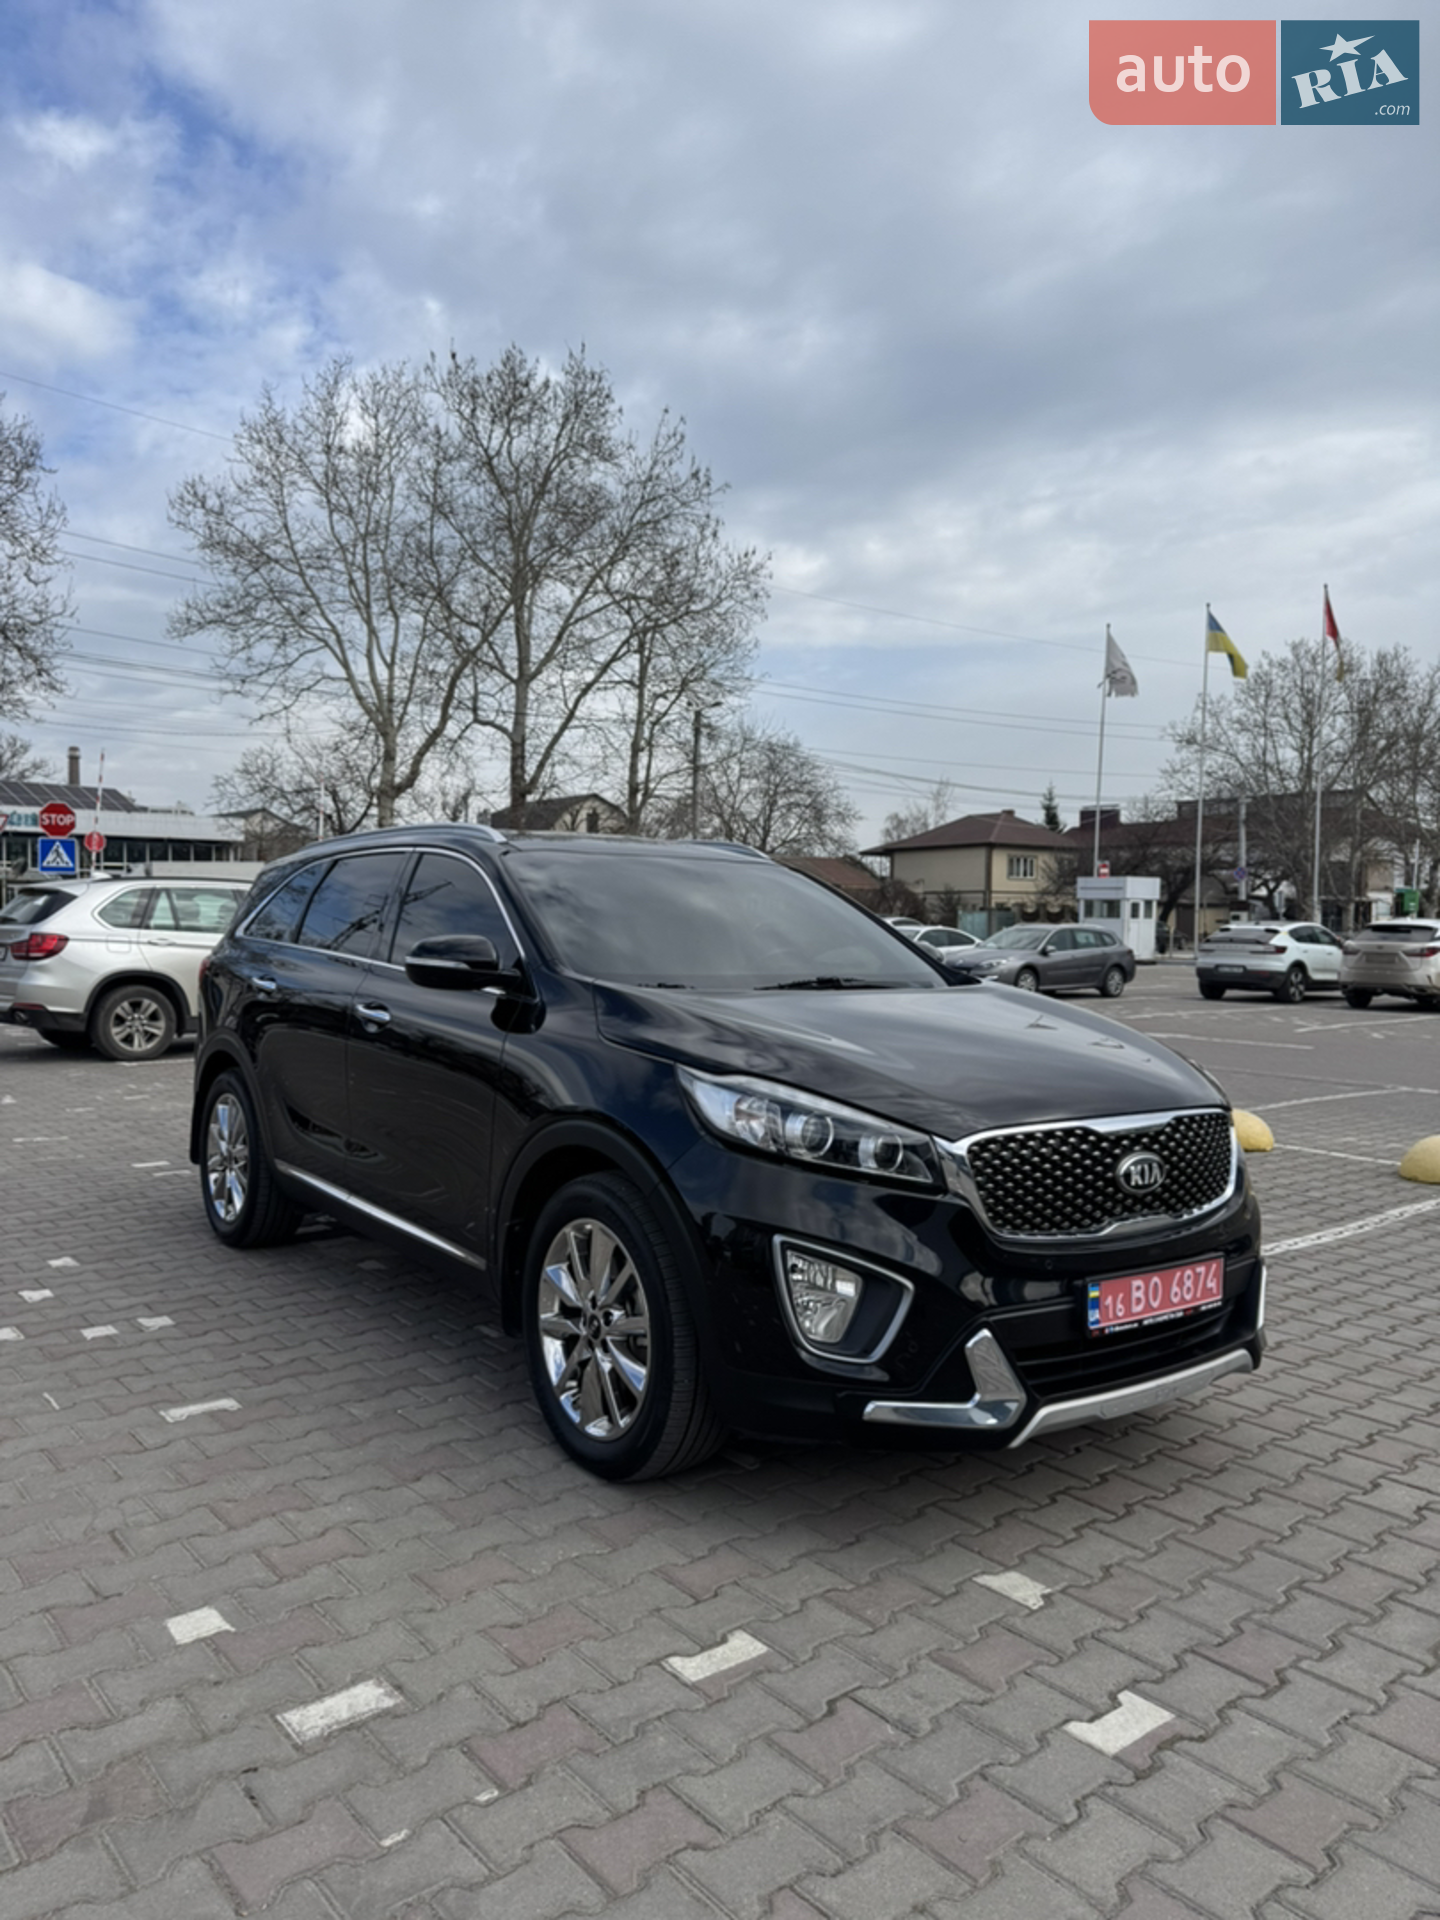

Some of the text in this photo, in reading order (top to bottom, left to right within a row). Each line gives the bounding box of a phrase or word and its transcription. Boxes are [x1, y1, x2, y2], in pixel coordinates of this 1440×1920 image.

[41, 813, 76, 826] STOP
[1129, 1162, 1162, 1187] KIA
[1105, 1263, 1217, 1319] 16 BO 6874
